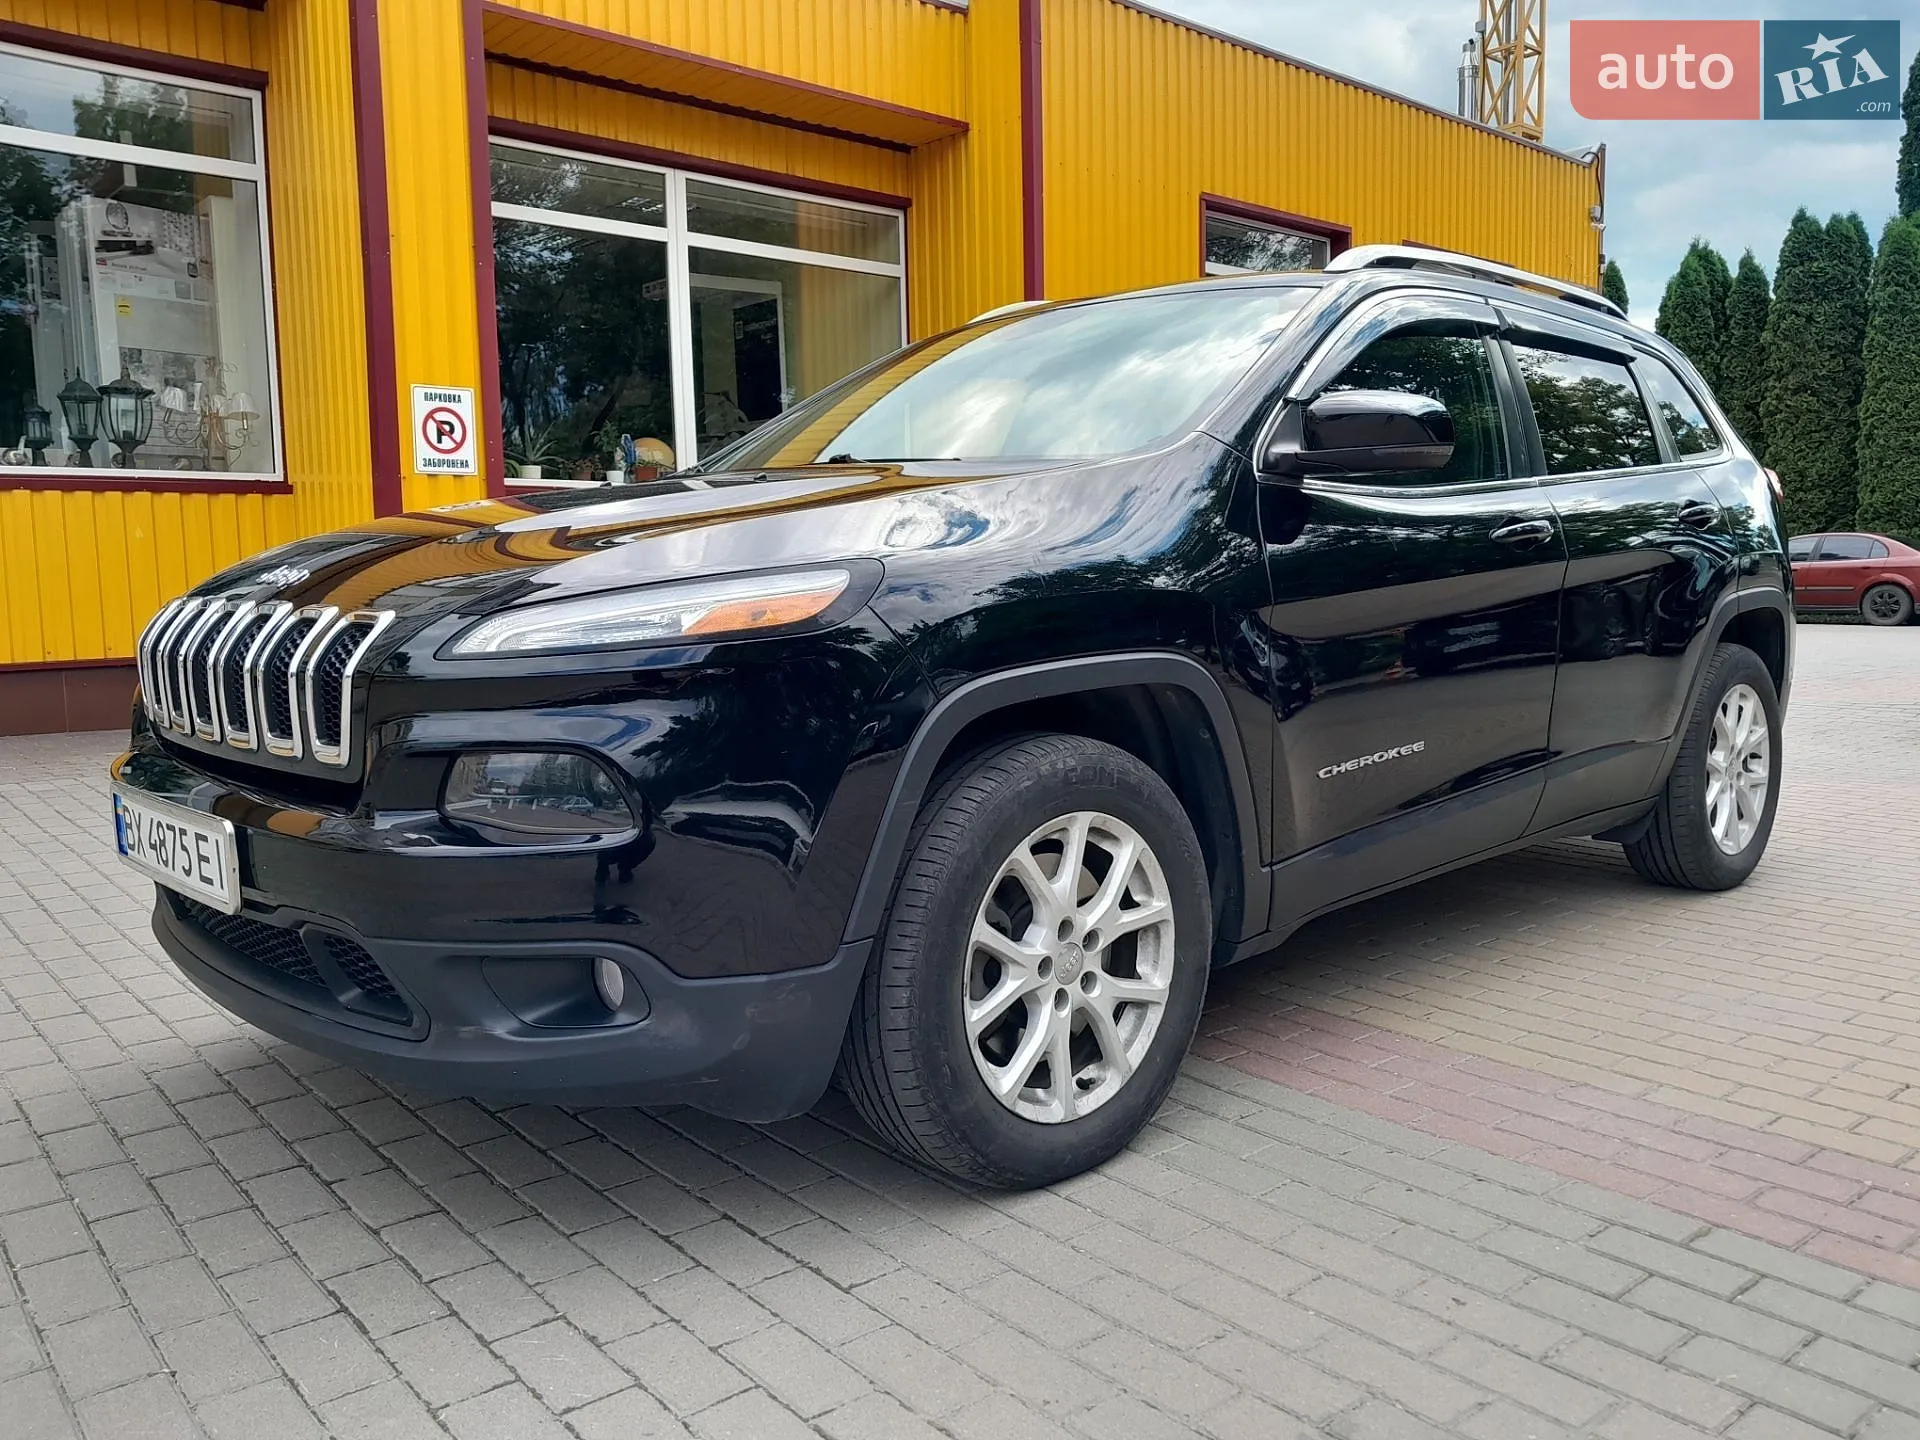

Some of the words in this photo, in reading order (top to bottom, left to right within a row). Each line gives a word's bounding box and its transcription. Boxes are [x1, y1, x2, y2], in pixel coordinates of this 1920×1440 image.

[423, 391, 462, 403] ПАРКОВКА
[422, 457, 470, 469] ЗАБОРОНЕНА
[1317, 740, 1425, 779] CHEROKEE
[148, 817, 192, 878] 4875
